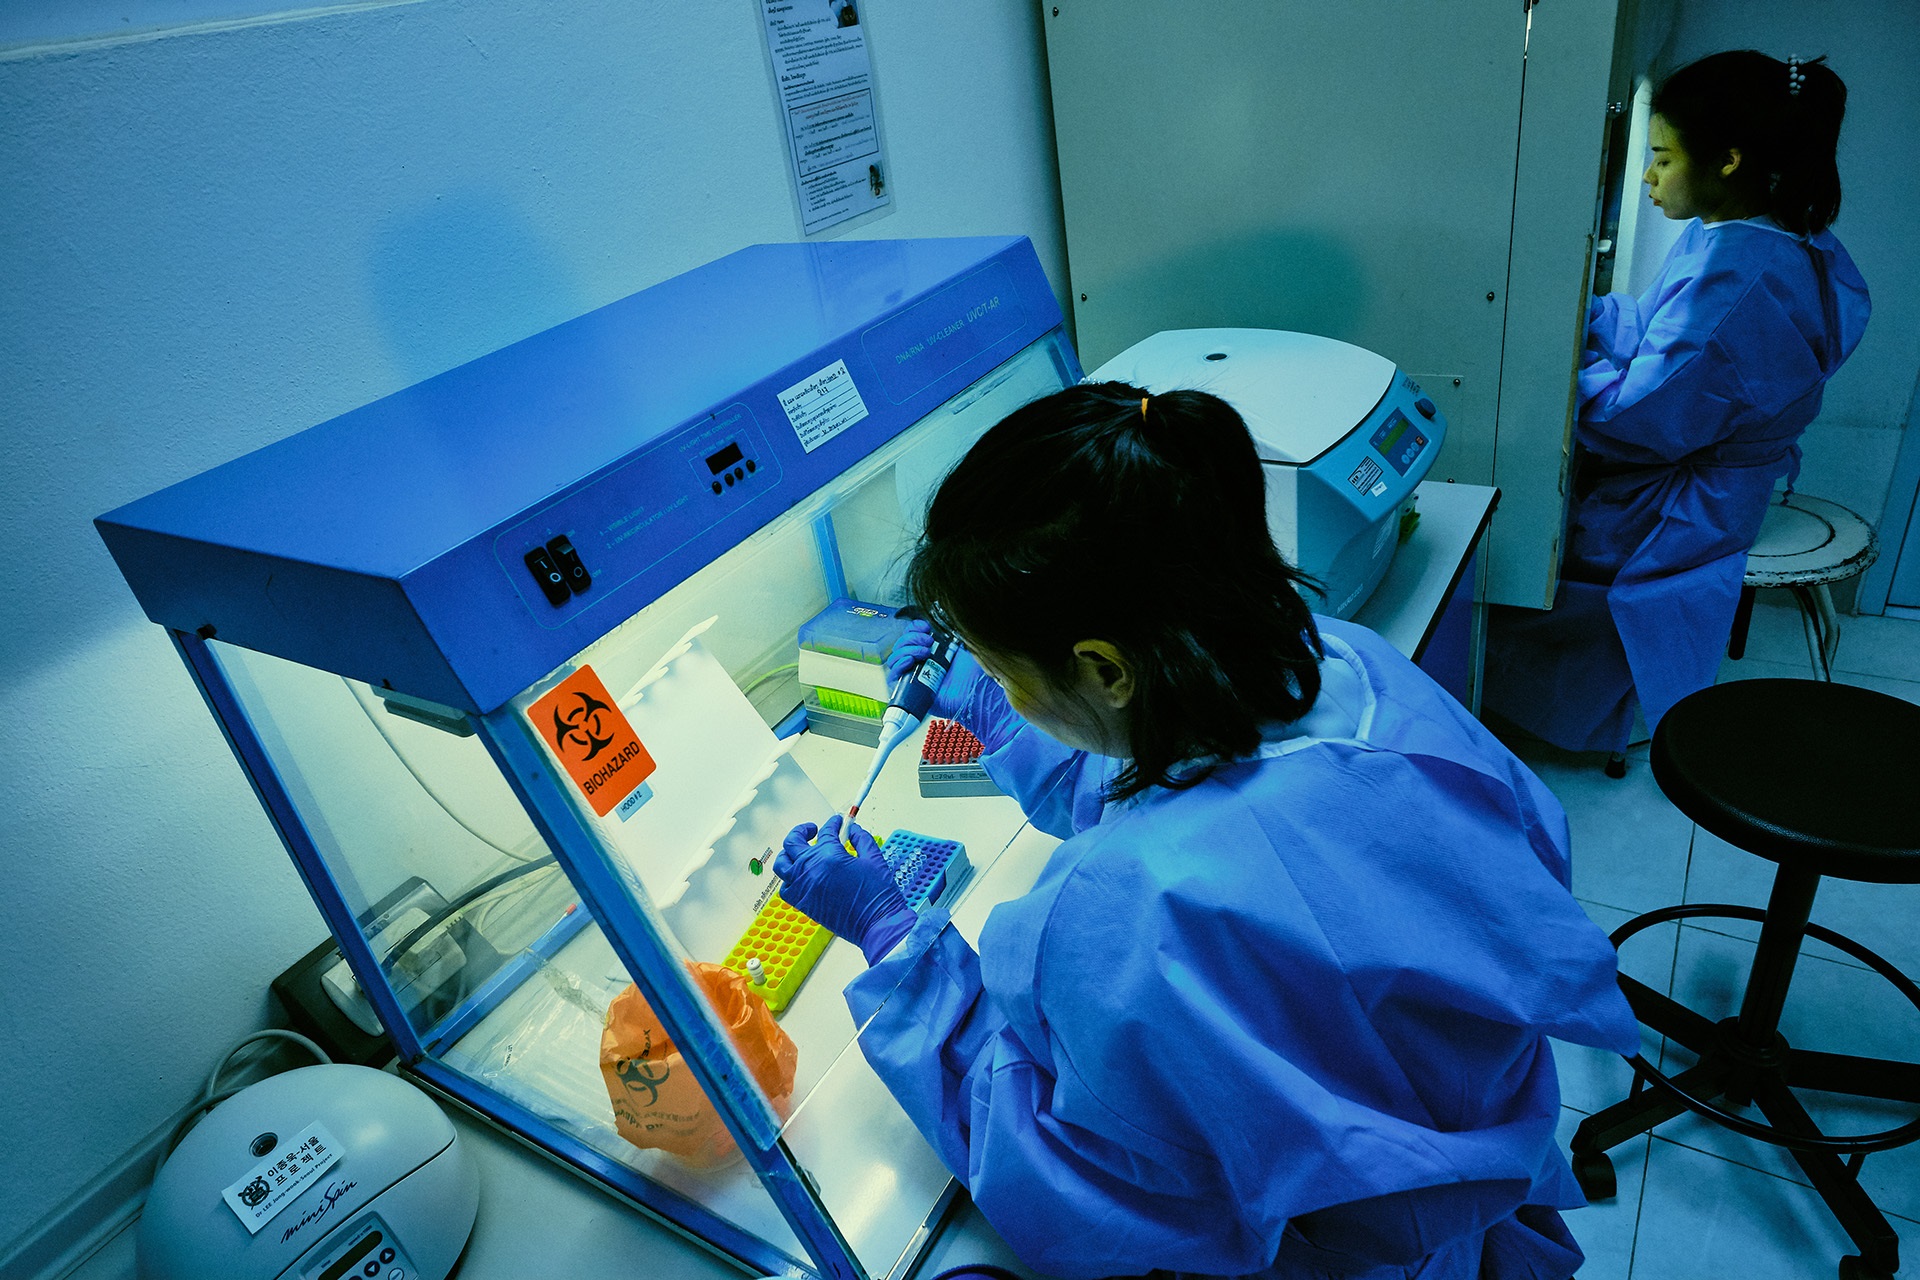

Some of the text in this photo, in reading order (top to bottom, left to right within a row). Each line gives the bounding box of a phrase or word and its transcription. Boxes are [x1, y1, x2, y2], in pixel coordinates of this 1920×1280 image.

[895, 296, 1000, 364] DNA/RNA UV-CLEANER UVC/T-AR
[711, 413, 742, 433] CONTROLLER
[583, 741, 640, 795] BIOHAZARD
[621, 796, 636, 813] HOOD
[267, 1136, 320, 1177] 이종욱-서울
[255, 1210, 263, 1218] Dr
[262, 1202, 273, 1212] LEE
[314, 1152, 333, 1169] Project
